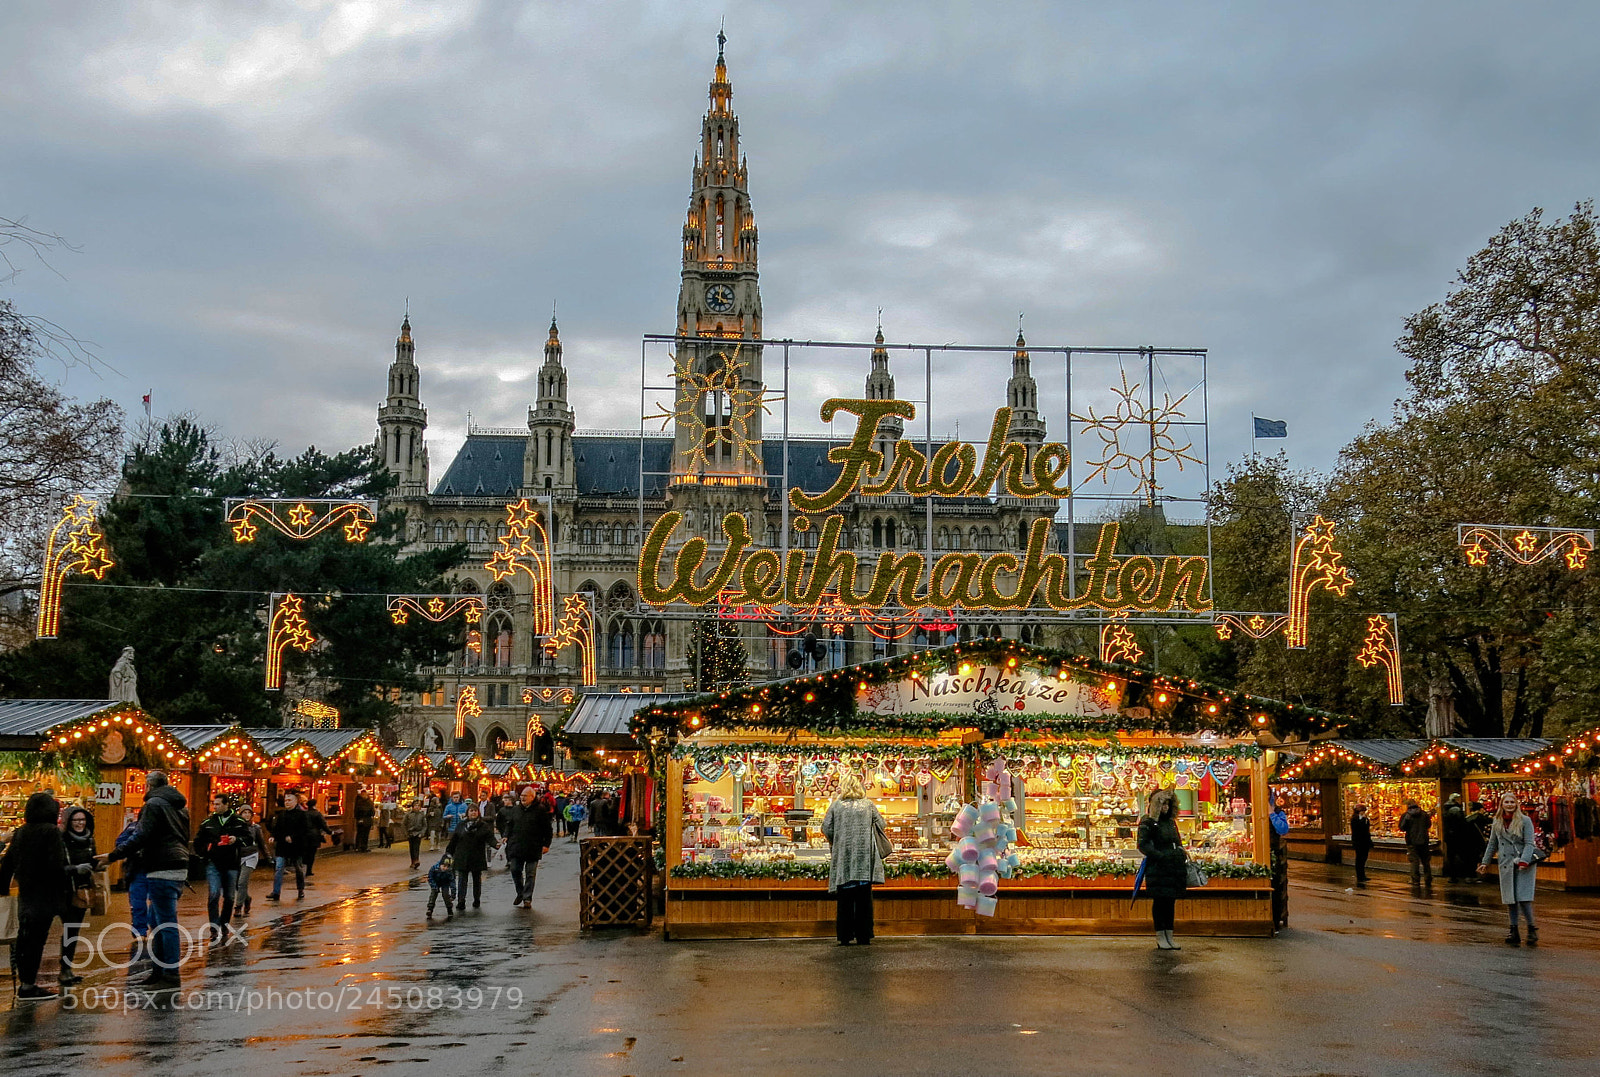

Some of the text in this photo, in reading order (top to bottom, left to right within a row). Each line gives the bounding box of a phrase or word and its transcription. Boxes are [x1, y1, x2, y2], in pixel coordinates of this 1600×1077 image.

[789, 398, 1071, 513] Frohe
[638, 510, 1214, 612] Weihnachten
[910, 668, 1068, 703] Naschkatze
